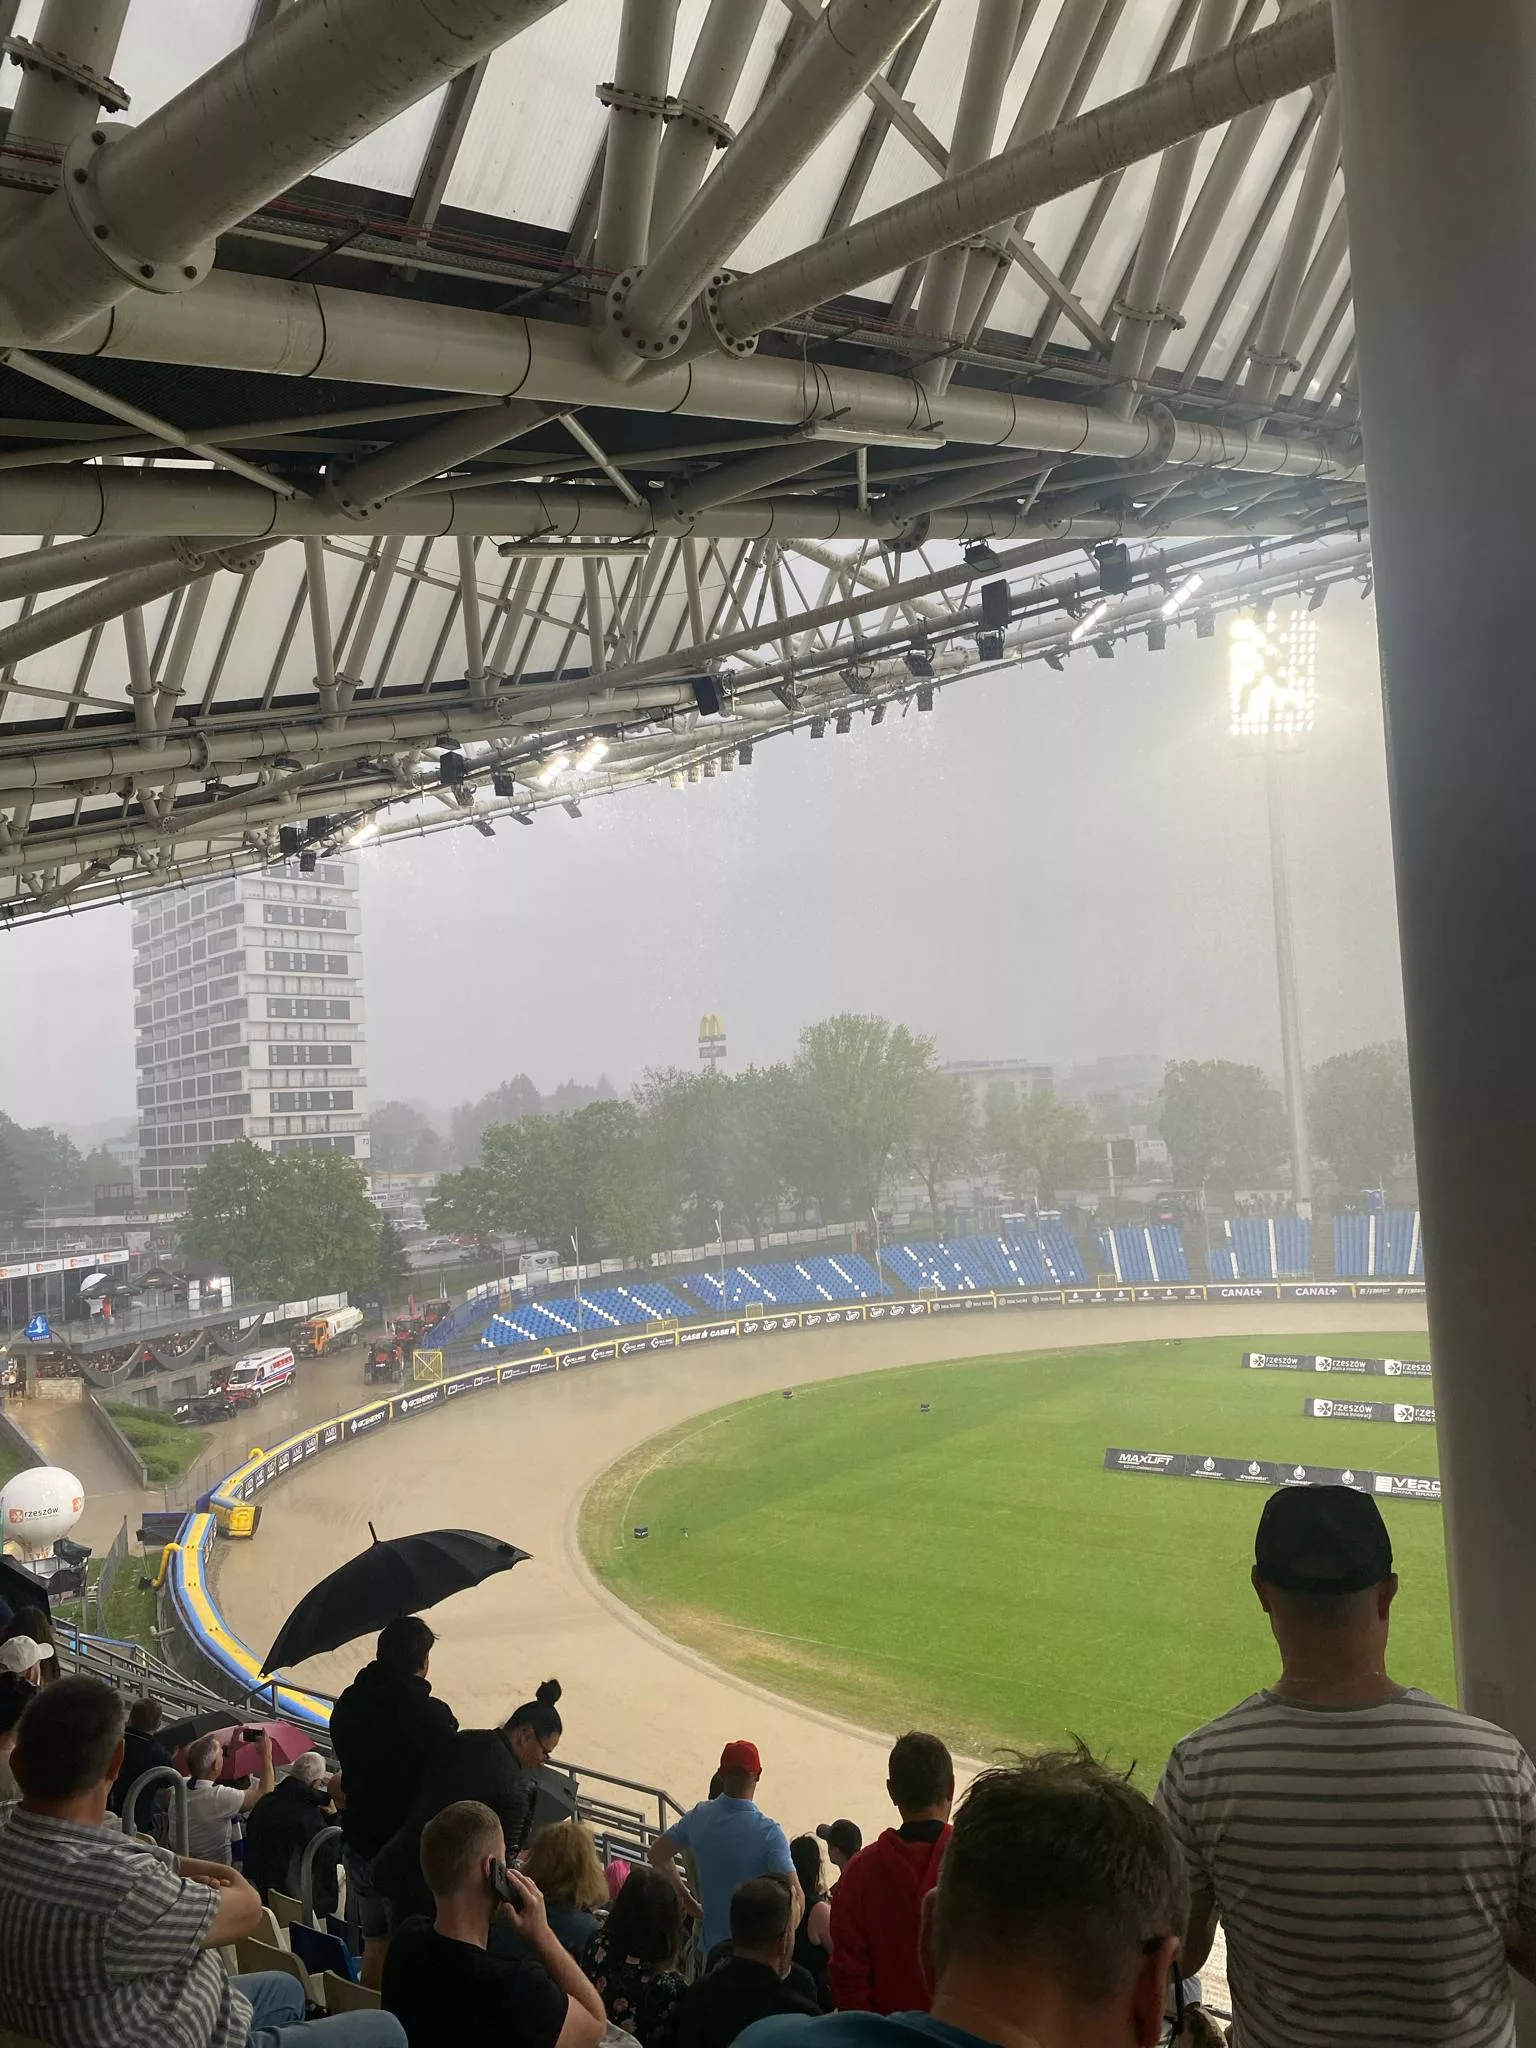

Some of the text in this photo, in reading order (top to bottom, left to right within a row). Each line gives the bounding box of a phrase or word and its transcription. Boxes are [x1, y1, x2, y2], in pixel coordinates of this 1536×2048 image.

[1221, 1288, 1262, 1297] CANAL+
[1295, 1288, 1337, 1296] CANAL+
[681, 1332, 700, 1342] CASE
[710, 1328, 729, 1337] CASE
[1265, 1356, 1298, 1365] rzeszów
[1332, 1359, 1366, 1368] rzeszów
[1402, 1363, 1431, 1371] rzeszó
[1333, 1403, 1373, 1413] rzeszów
[1415, 1408, 1436, 1417] rzes
[1119, 1453, 1173, 1465] MAXLIFT
[24, 1507, 59, 1518] rzeszów
